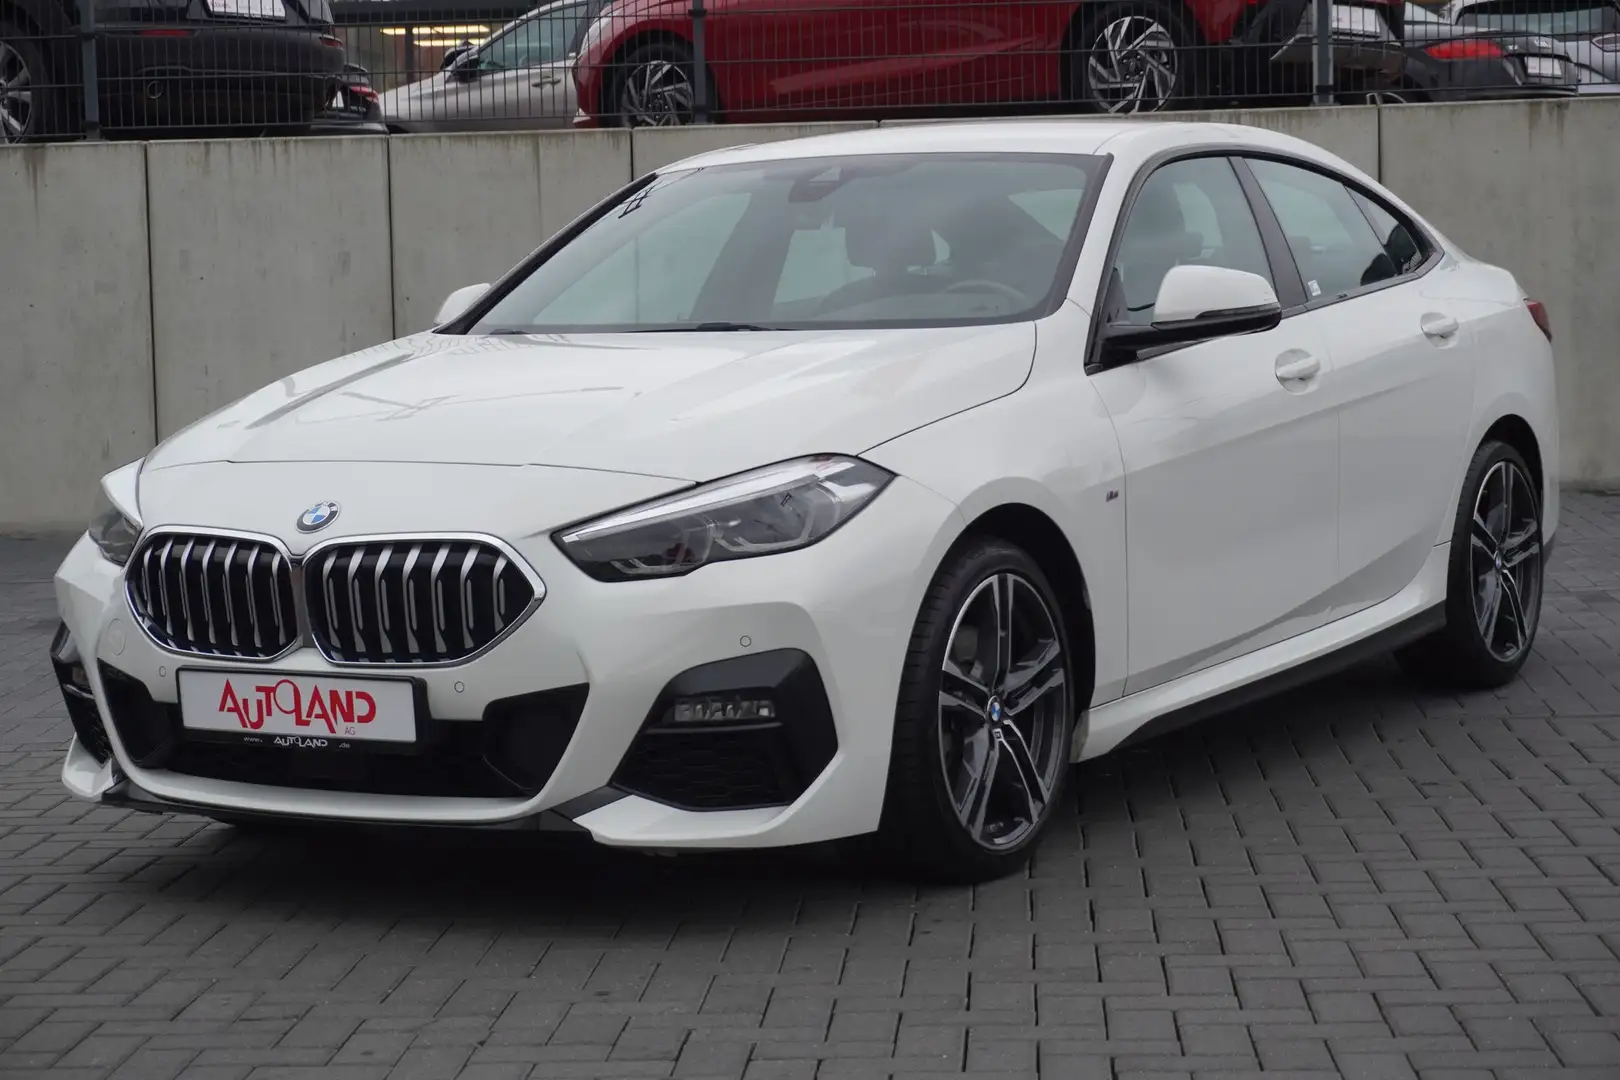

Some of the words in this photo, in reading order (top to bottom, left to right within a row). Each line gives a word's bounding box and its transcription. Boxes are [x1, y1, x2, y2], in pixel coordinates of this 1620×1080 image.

[219, 678, 376, 734] AUTOLAND
[344, 726, 356, 735] AG
[273, 736, 328, 748] AUTOLAND
